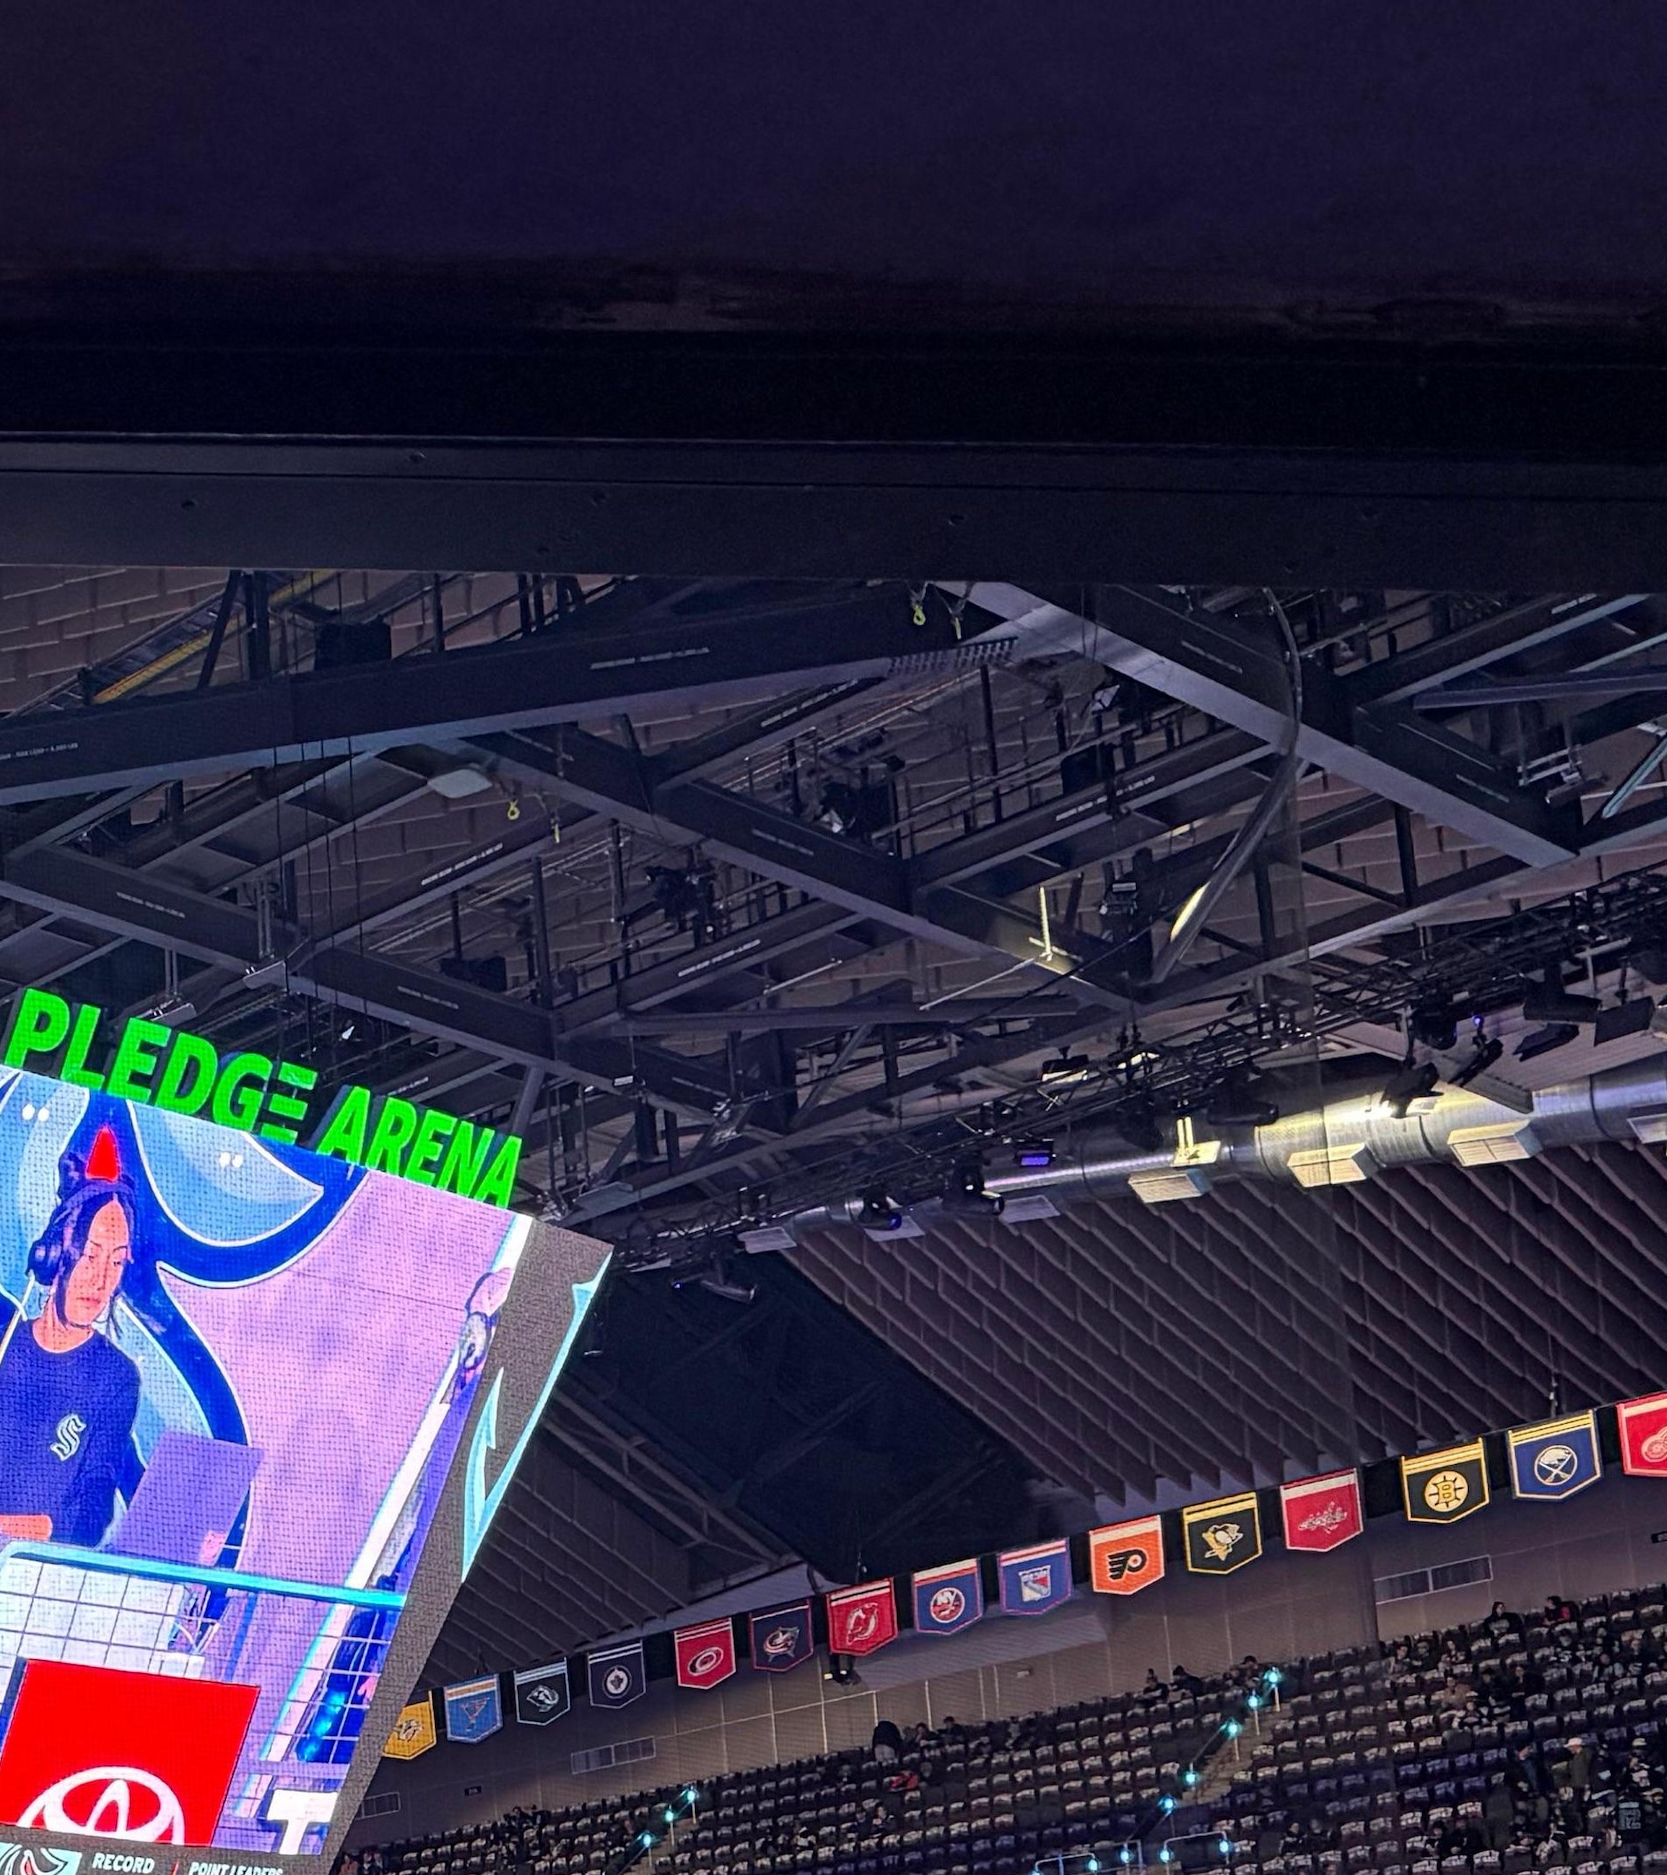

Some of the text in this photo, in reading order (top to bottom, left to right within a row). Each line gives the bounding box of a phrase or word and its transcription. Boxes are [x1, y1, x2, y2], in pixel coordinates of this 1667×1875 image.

[6, 988, 321, 1142] PLEDGE
[316, 1084, 523, 1209] ARENA
[93, 1852, 155, 1875] RECORD
